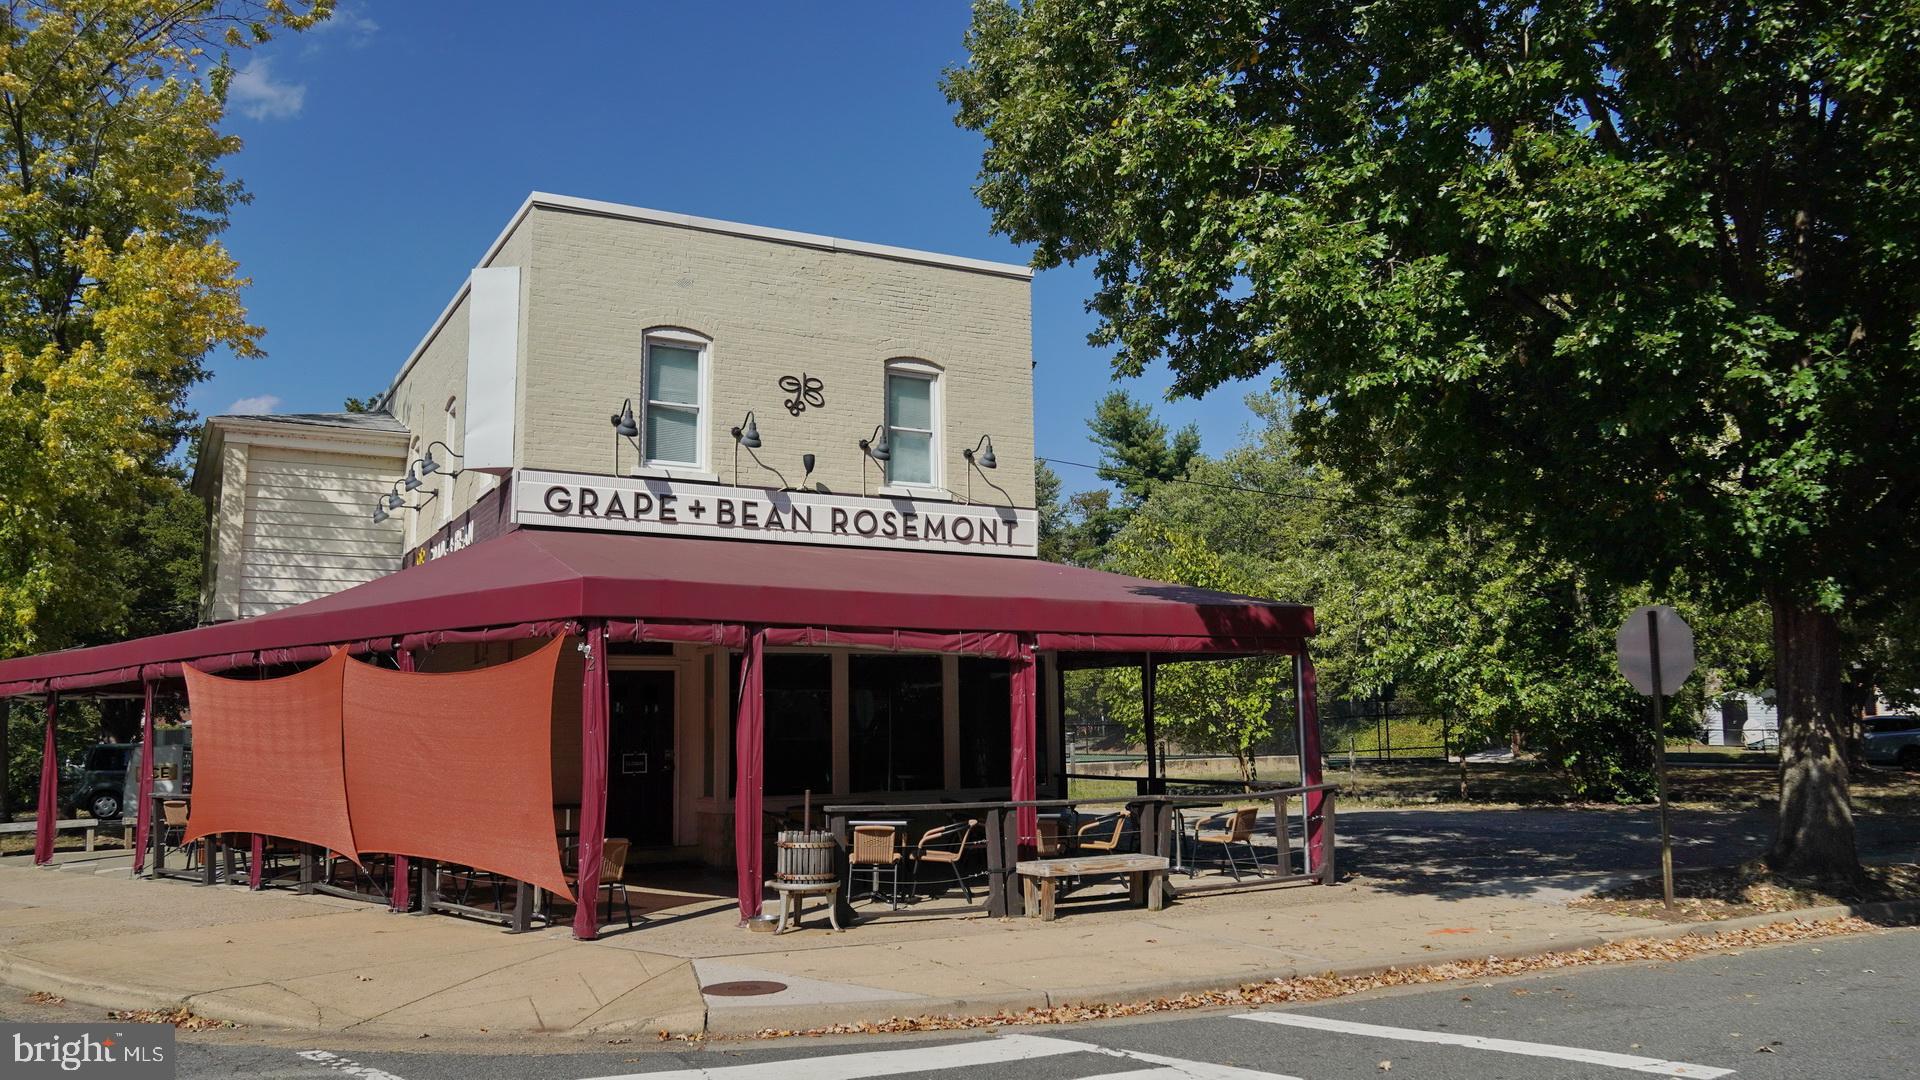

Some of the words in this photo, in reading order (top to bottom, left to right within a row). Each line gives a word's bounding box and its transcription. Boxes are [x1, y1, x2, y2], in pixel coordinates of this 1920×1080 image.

[544, 485, 677, 521] GRAPE
[689, 499, 706, 518] +
[717, 498, 812, 532] BEAN
[831, 506, 1017, 544] ROSEMONT
